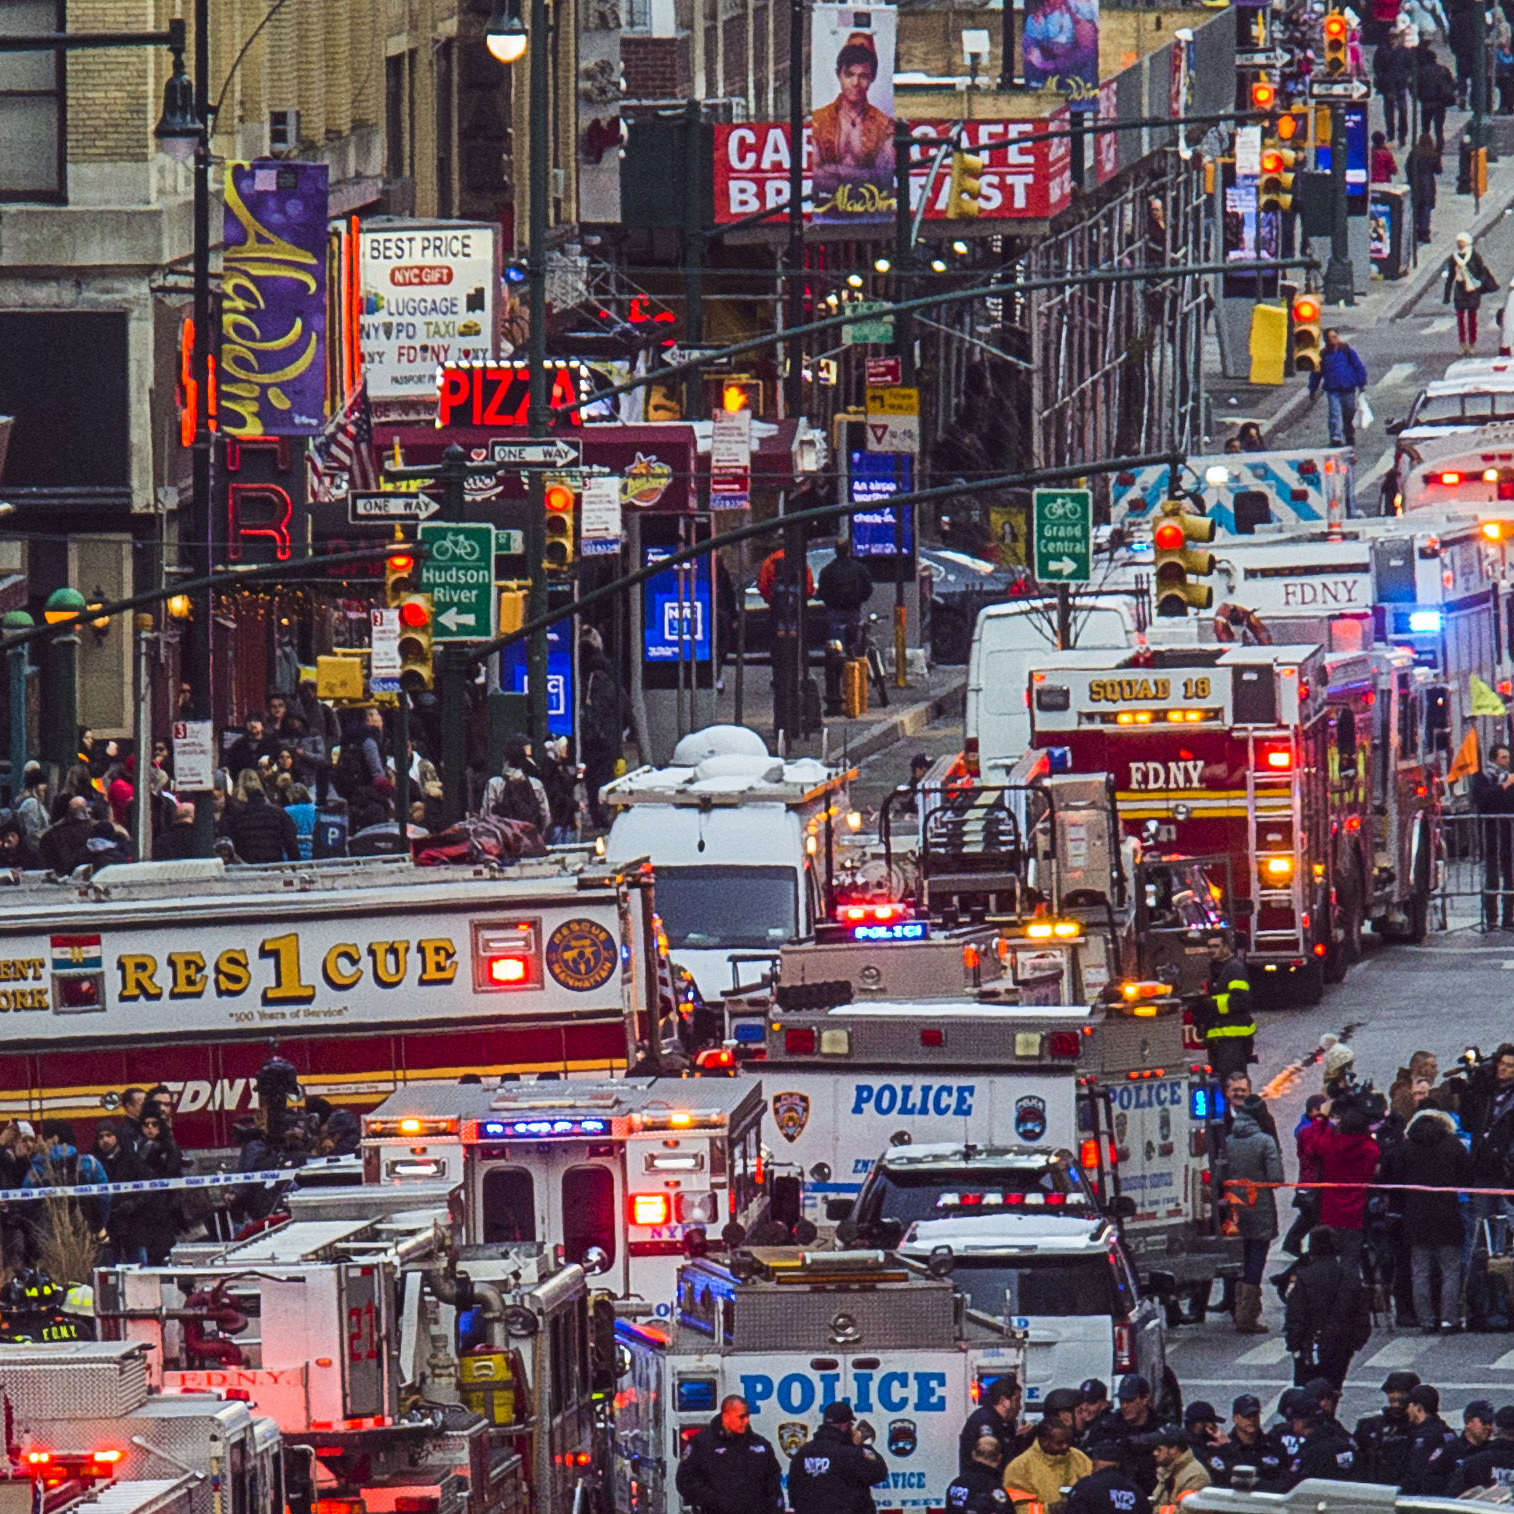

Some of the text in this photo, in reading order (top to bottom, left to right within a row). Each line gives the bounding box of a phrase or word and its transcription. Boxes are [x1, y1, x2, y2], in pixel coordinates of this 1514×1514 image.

[370, 234, 472, 260] BEST PRICE
[393, 268, 450, 285] NYC GIFT
[221, 160, 318, 436] Aladdin
[386, 297, 459, 316] LUGGAGE
[424, 321, 457, 339] TAXI
[497, 447, 571, 461] ONE WAY
[362, 499, 432, 513] ONE WAY
[1043, 524, 1083, 537] Grand
[1039, 540, 1087, 554] Central
[421, 566, 489, 585] Hudson
[433, 587, 479, 604] River
[1089, 677, 1212, 702] SQUAD 18
[852, 1084, 977, 1117] POLICE
[348, 1298, 378, 1363] 21
[739, 1371, 947, 1415] POLICE
[804, 1457, 830, 1474] NYPD
